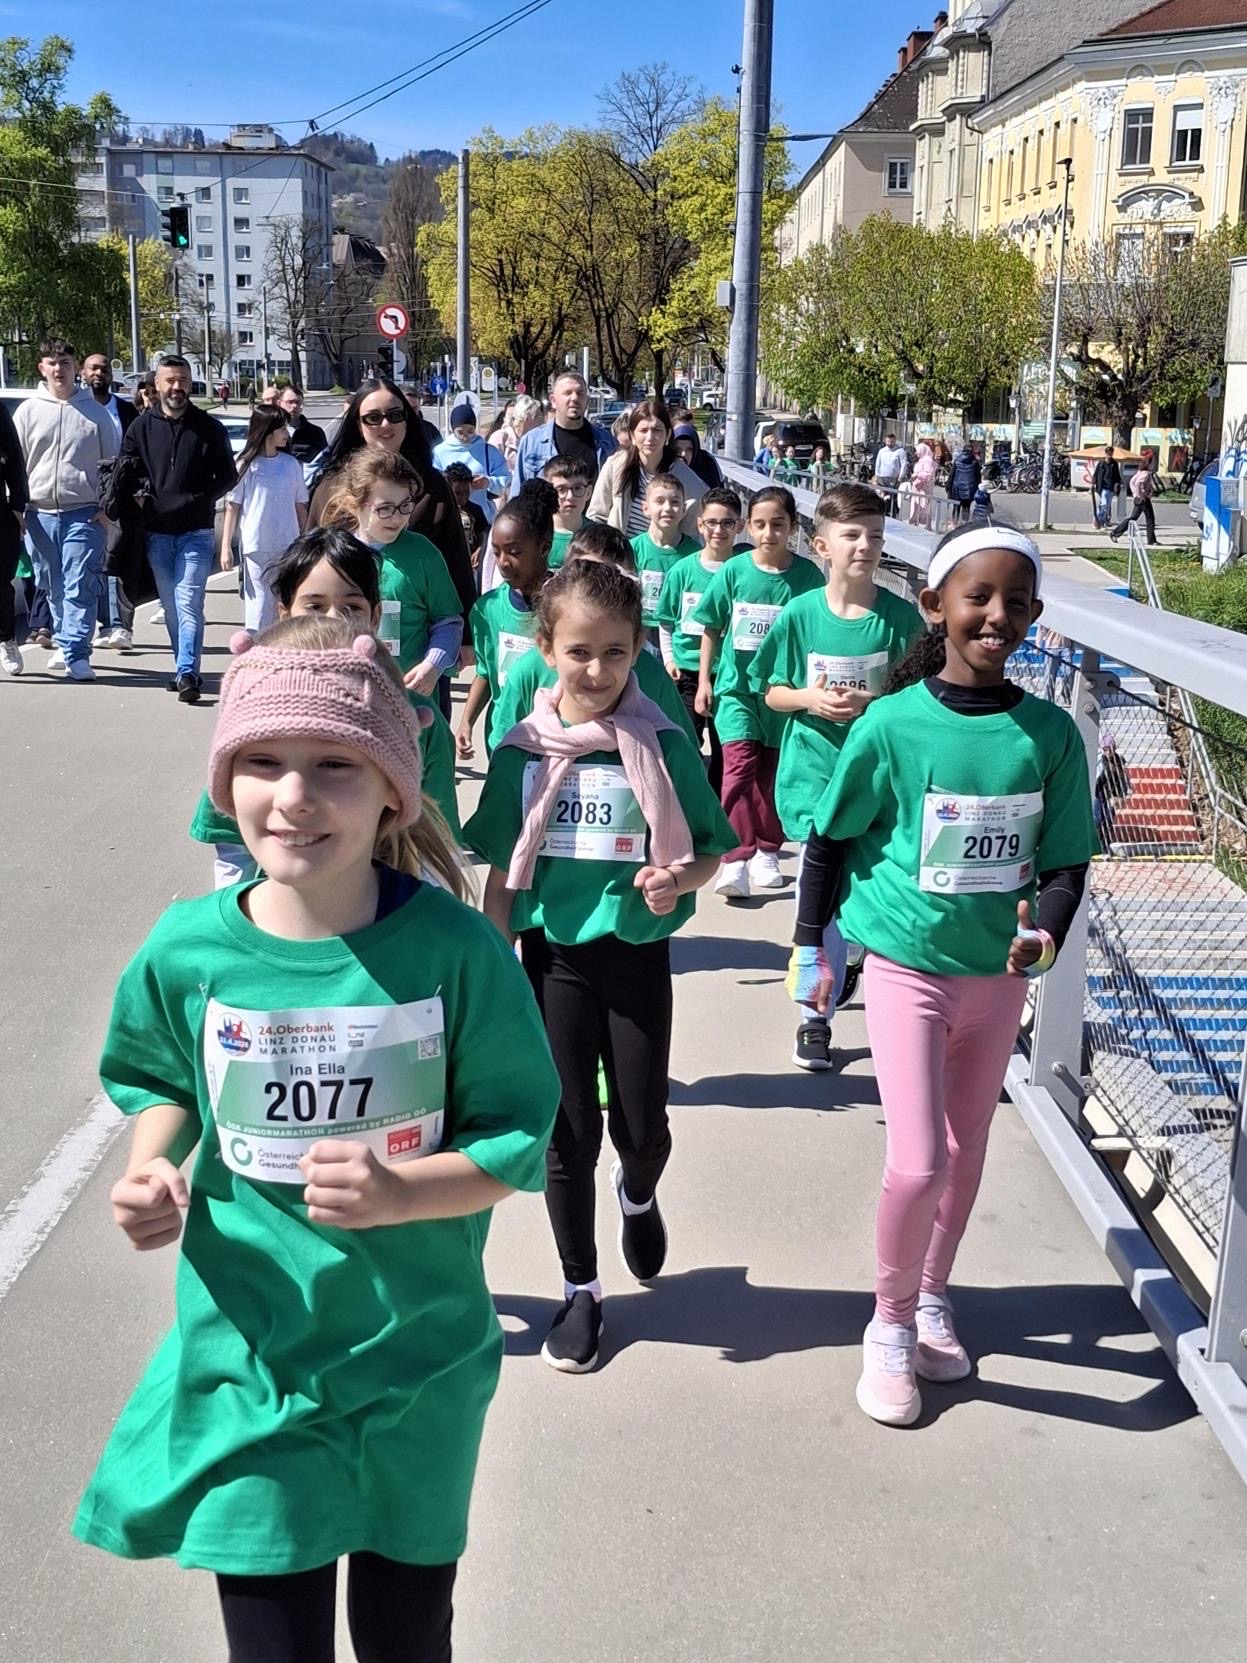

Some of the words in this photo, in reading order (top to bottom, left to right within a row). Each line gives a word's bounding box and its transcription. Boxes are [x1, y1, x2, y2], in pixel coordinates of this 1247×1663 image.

[749, 622, 770, 635] 208
[556, 799, 612, 826] 2083
[984, 826, 1006, 834] Emily
[963, 833, 1020, 859] 2079
[258, 1037, 285, 1046] LINZ
[291, 1034, 336, 1044] DONAU
[260, 1045, 337, 1056] MARATHON
[289, 1064, 313, 1076] Ina
[318, 1062, 346, 1075] Ella
[264, 1077, 374, 1122] 2077
[327, 1122, 367, 1135] powered
[369, 1120, 381, 1128] by
[382, 1111, 412, 1125] RADIO
[390, 1138, 420, 1153] ORF
[257, 1148, 305, 1161] Österreich
[258, 1158, 301, 1170] Gesundh
